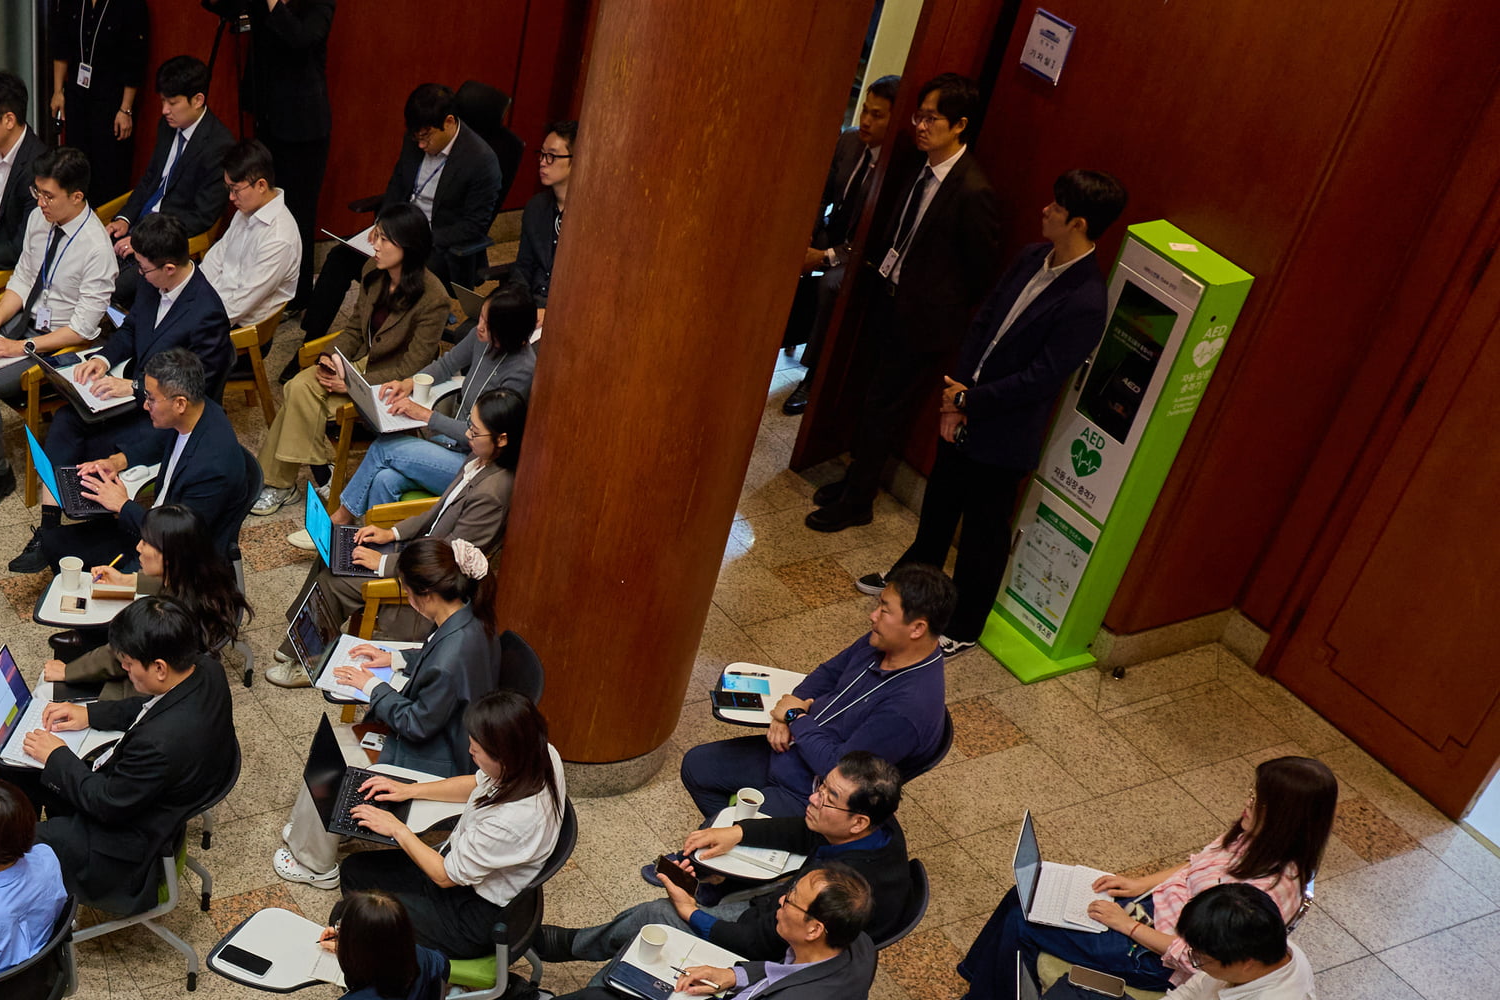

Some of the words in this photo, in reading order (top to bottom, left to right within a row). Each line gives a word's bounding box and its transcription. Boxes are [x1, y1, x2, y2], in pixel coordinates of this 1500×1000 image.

[1202, 324, 1229, 340] AED
[1121, 377, 1141, 394] AED
[1080, 426, 1106, 450] AED
[1053, 466, 1067, 481] 자동
[1066, 476, 1078, 490] 심장
[1078, 485, 1097, 504] 충격기
